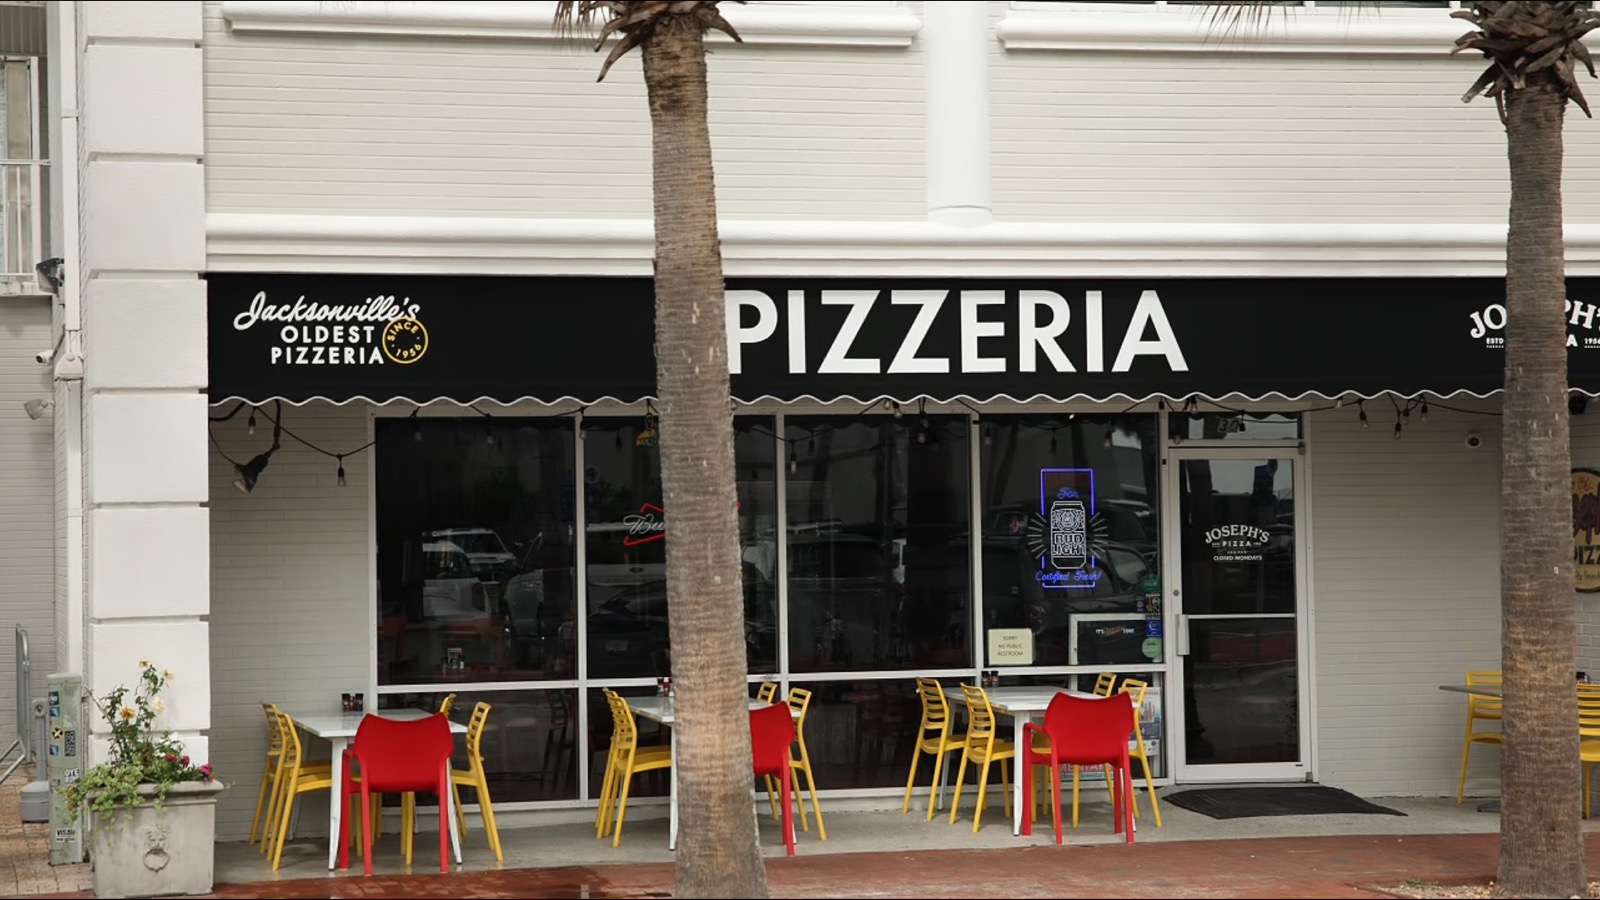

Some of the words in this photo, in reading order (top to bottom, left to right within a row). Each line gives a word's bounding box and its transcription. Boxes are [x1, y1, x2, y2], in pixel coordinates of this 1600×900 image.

[233, 290, 421, 331] Jacksonville's
[280, 324, 375, 344] OLDEST
[387, 321, 419, 342] SINCE
[724, 288, 1190, 375] PIZZERIA
[271, 346, 385, 365] PIZZERIA
[395, 343, 422, 359] 1956
[1054, 533, 1084, 546] BUD
[1204, 524, 1271, 544] JOSEPH'S
[1051, 545, 1086, 556] LIGHT
[1036, 571, 1070, 583] Certified
